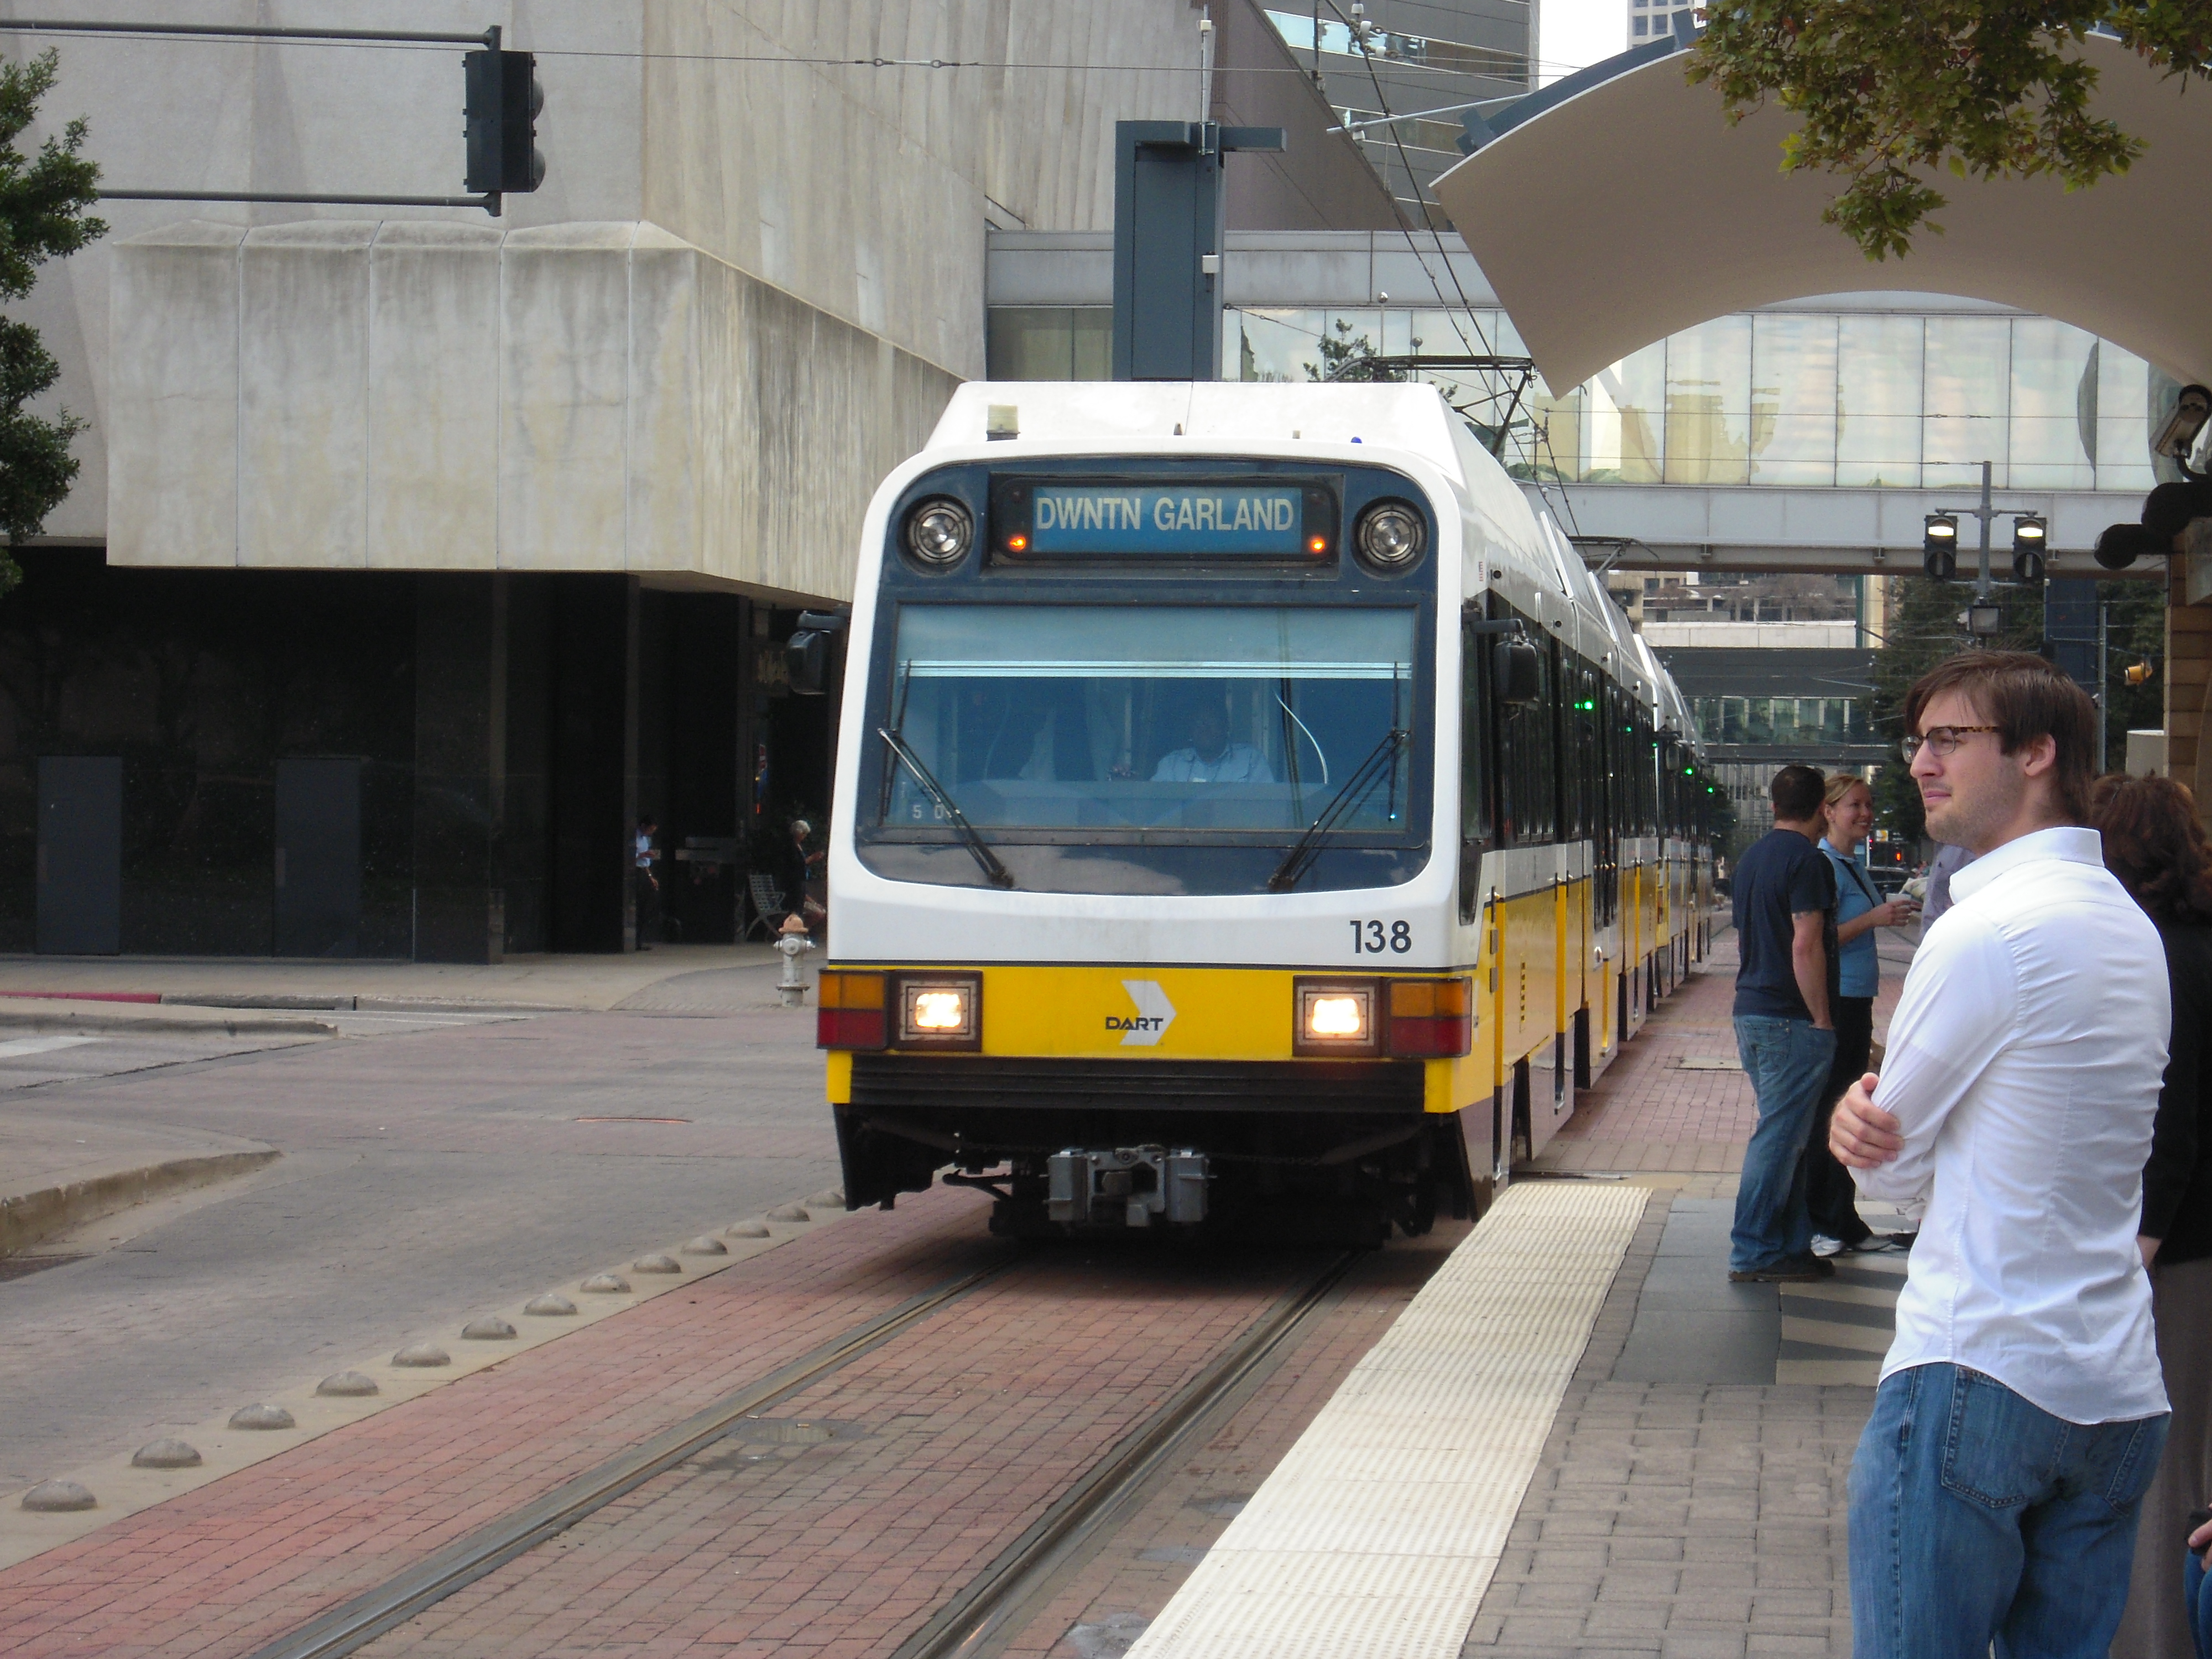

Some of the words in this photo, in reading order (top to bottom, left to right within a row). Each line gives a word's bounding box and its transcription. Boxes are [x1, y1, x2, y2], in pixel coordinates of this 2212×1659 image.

[1036, 497, 1141, 530] DWNTN
[1154, 497, 1294, 531] GARLAND
[1349, 920, 1412, 953] 138
[1105, 1016, 1164, 1031] DART
